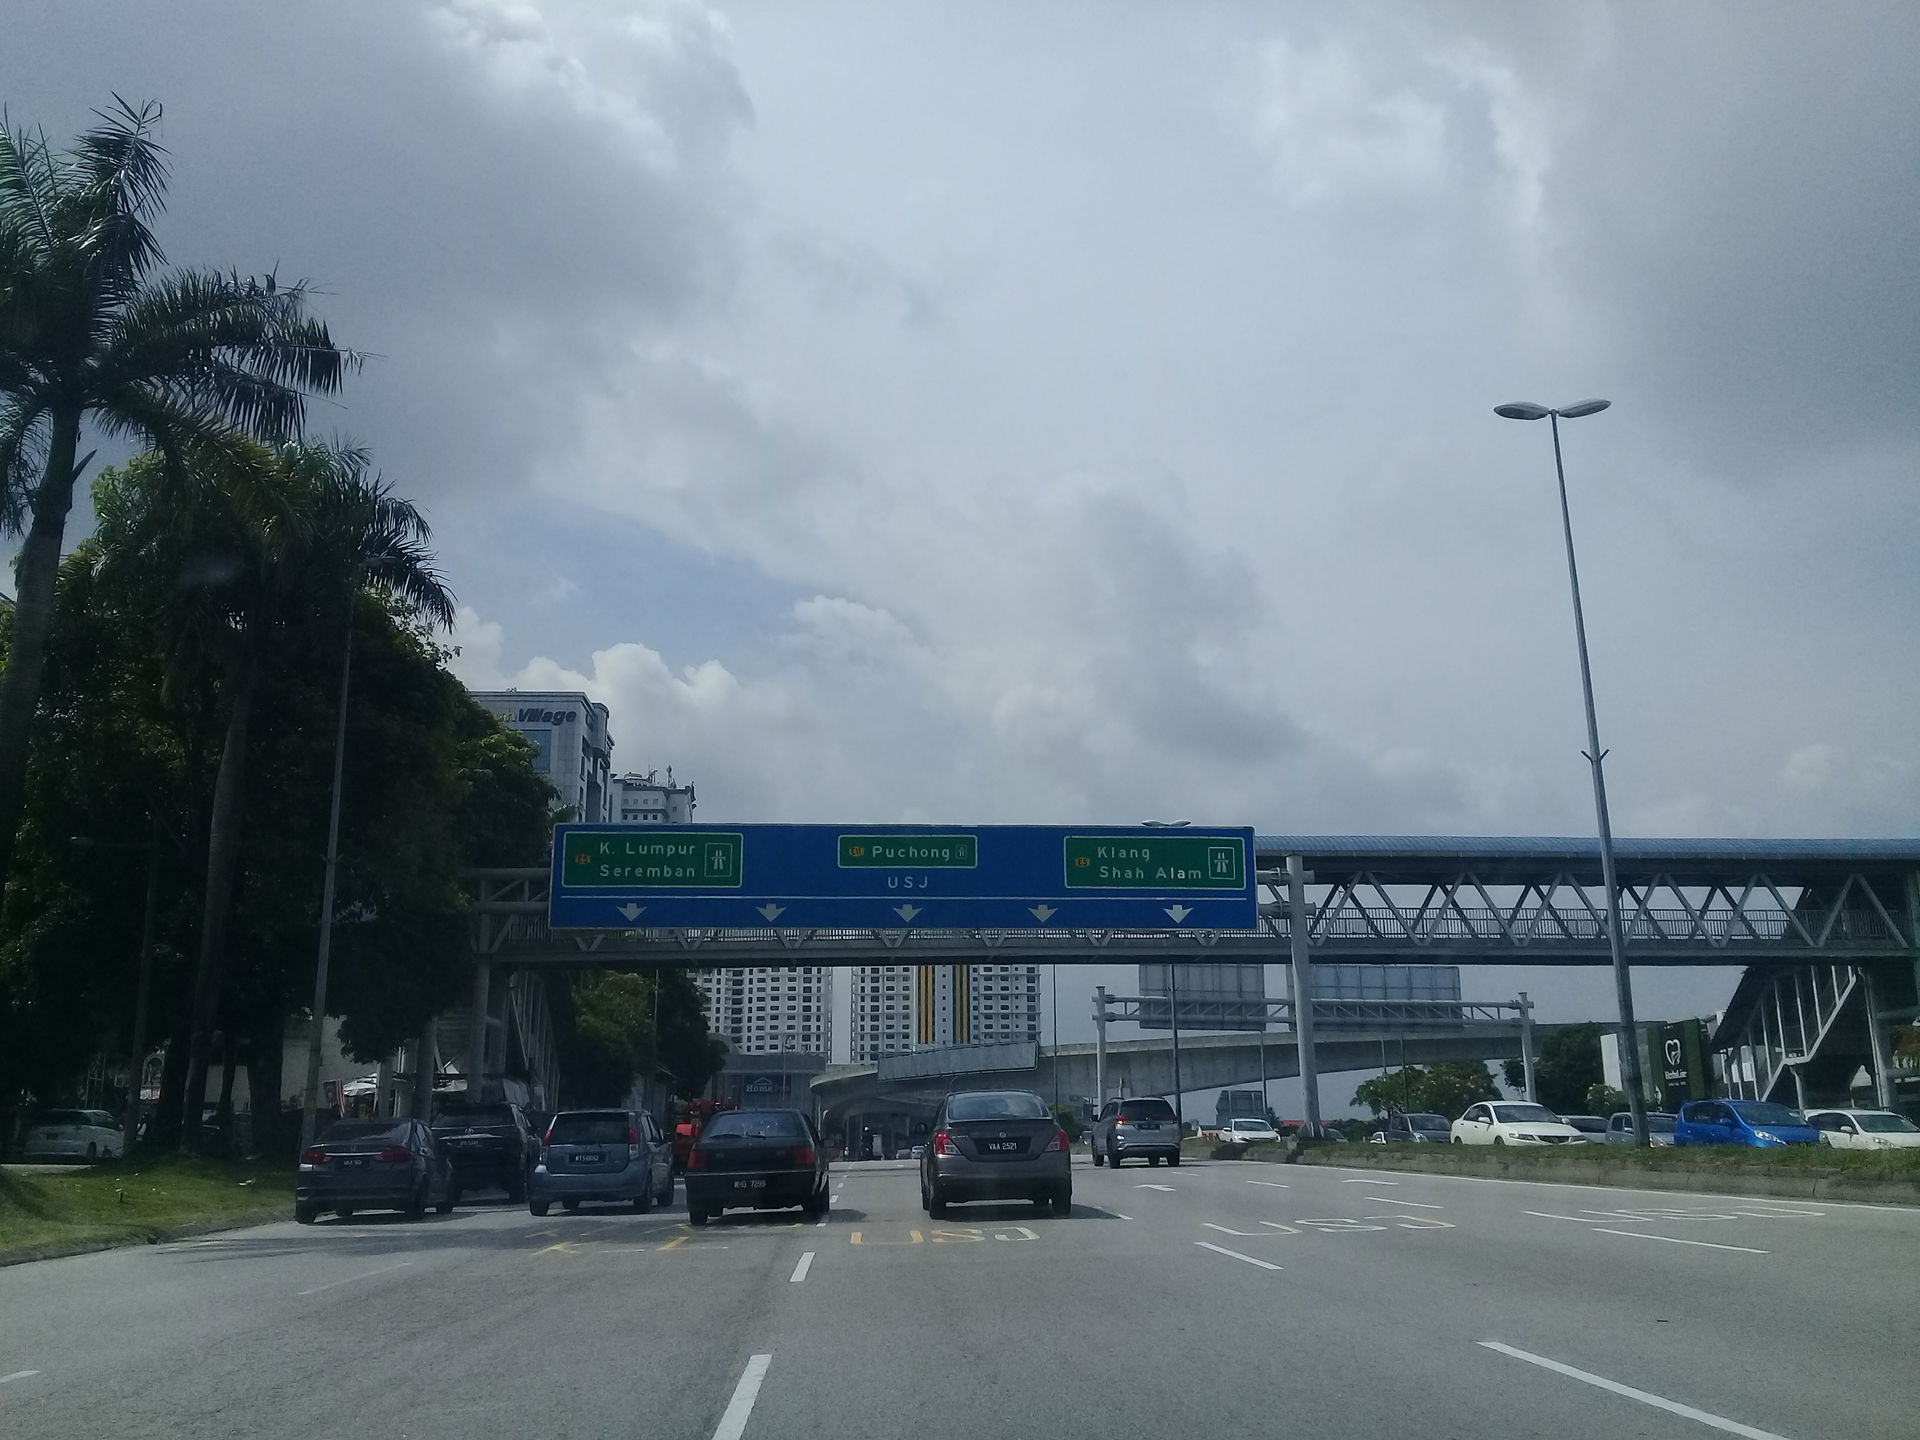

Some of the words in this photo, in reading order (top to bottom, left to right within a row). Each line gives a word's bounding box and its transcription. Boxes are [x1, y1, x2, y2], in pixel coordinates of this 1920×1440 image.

[518, 708, 577, 726] Village
[599, 841, 615, 854] K.
[625, 842, 696, 857] Lumpur
[872, 845, 950, 862] Puchong
[1097, 846, 1150, 862] Klang
[599, 864, 696, 877] Seremban
[1099, 865, 1144, 879] Shah
[1155, 866, 1202, 879] Alam
[887, 876, 928, 889] USJ
[988, 1142, 1001, 1150] VAA
[1002, 1142, 1017, 1150] 2521
